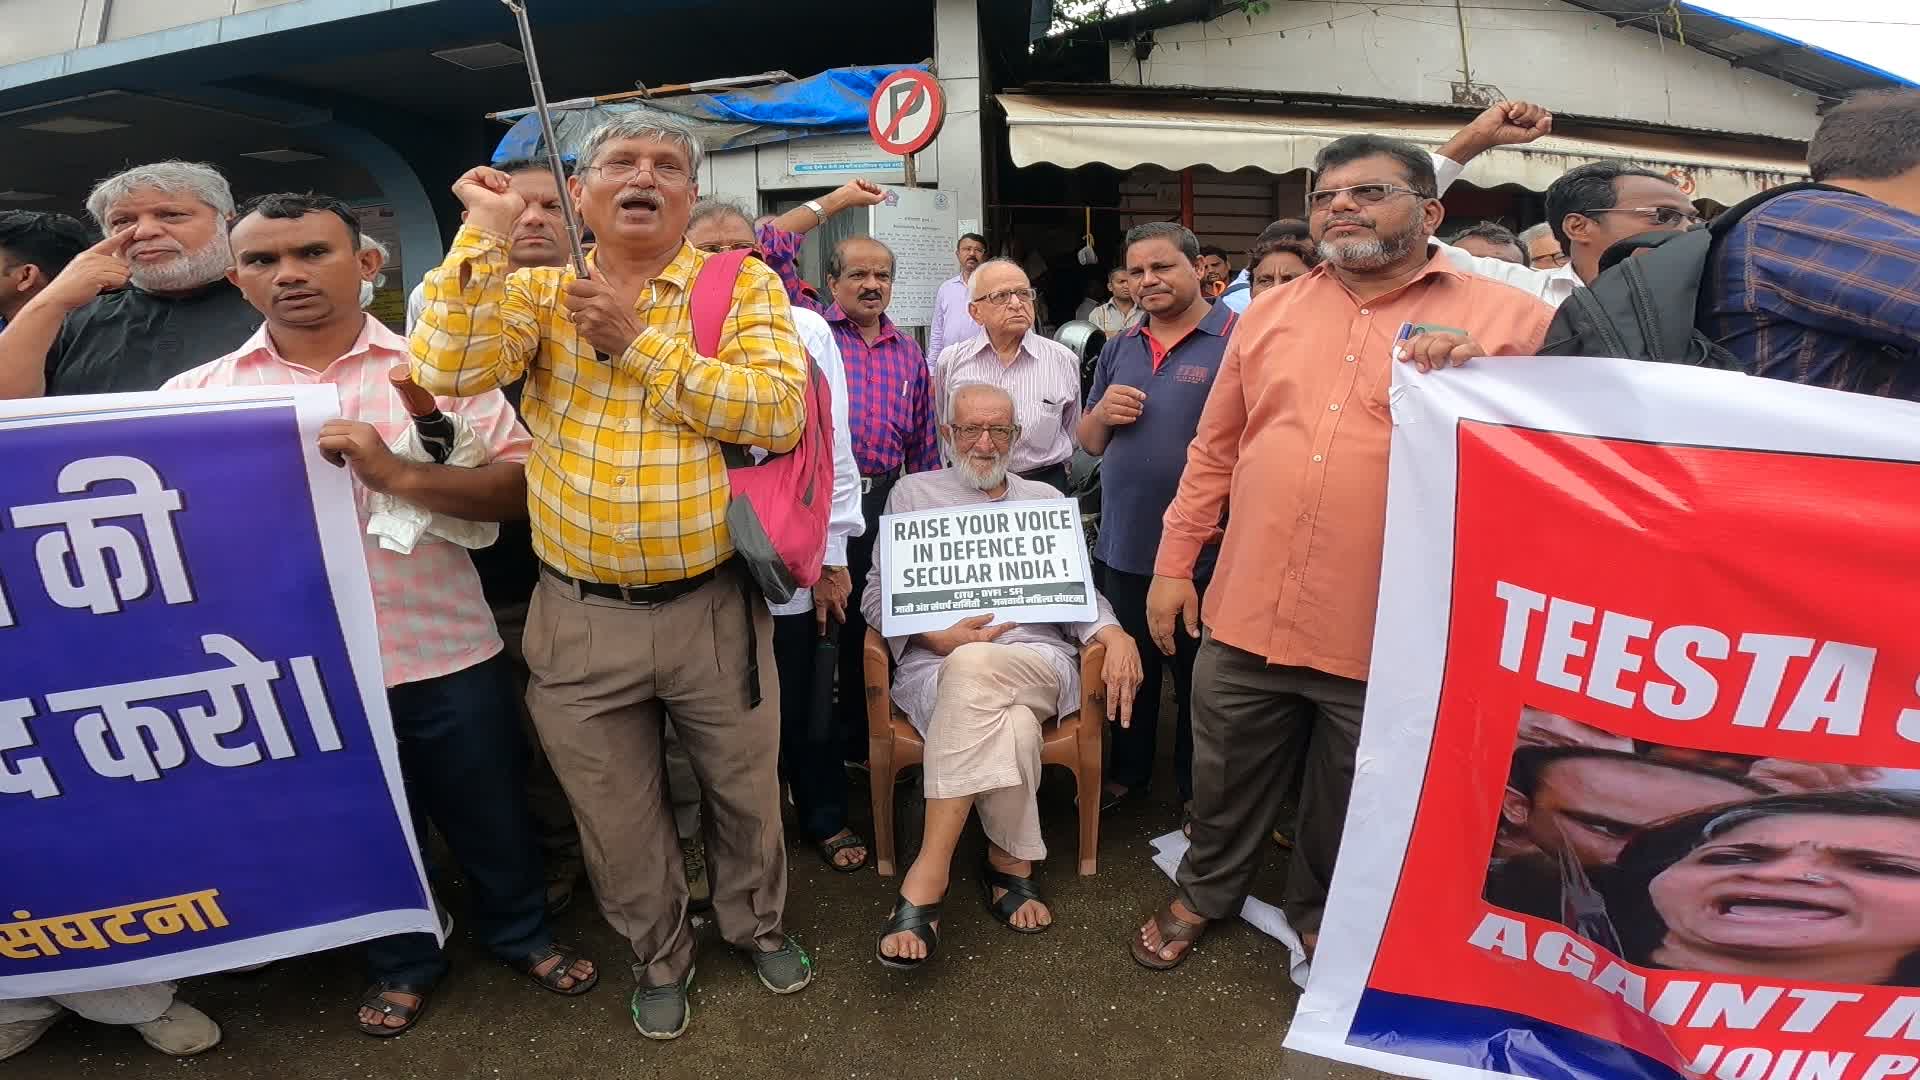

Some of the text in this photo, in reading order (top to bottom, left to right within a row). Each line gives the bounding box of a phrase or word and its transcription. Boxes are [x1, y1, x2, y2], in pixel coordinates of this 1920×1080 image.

[10, 455, 193, 615] की
[894, 510, 1072, 542] RAISE YOUR VOICE
[913, 535, 1056, 564] IN DEFENCE OF
[903, 563, 992, 588] SECULAR
[999, 558, 1056, 582] INDIA
[1496, 580, 1878, 736] TEESTA
[1467, 912, 1864, 1032] AGAINT
[1684, 1044, 1856, 1080] JOIN
